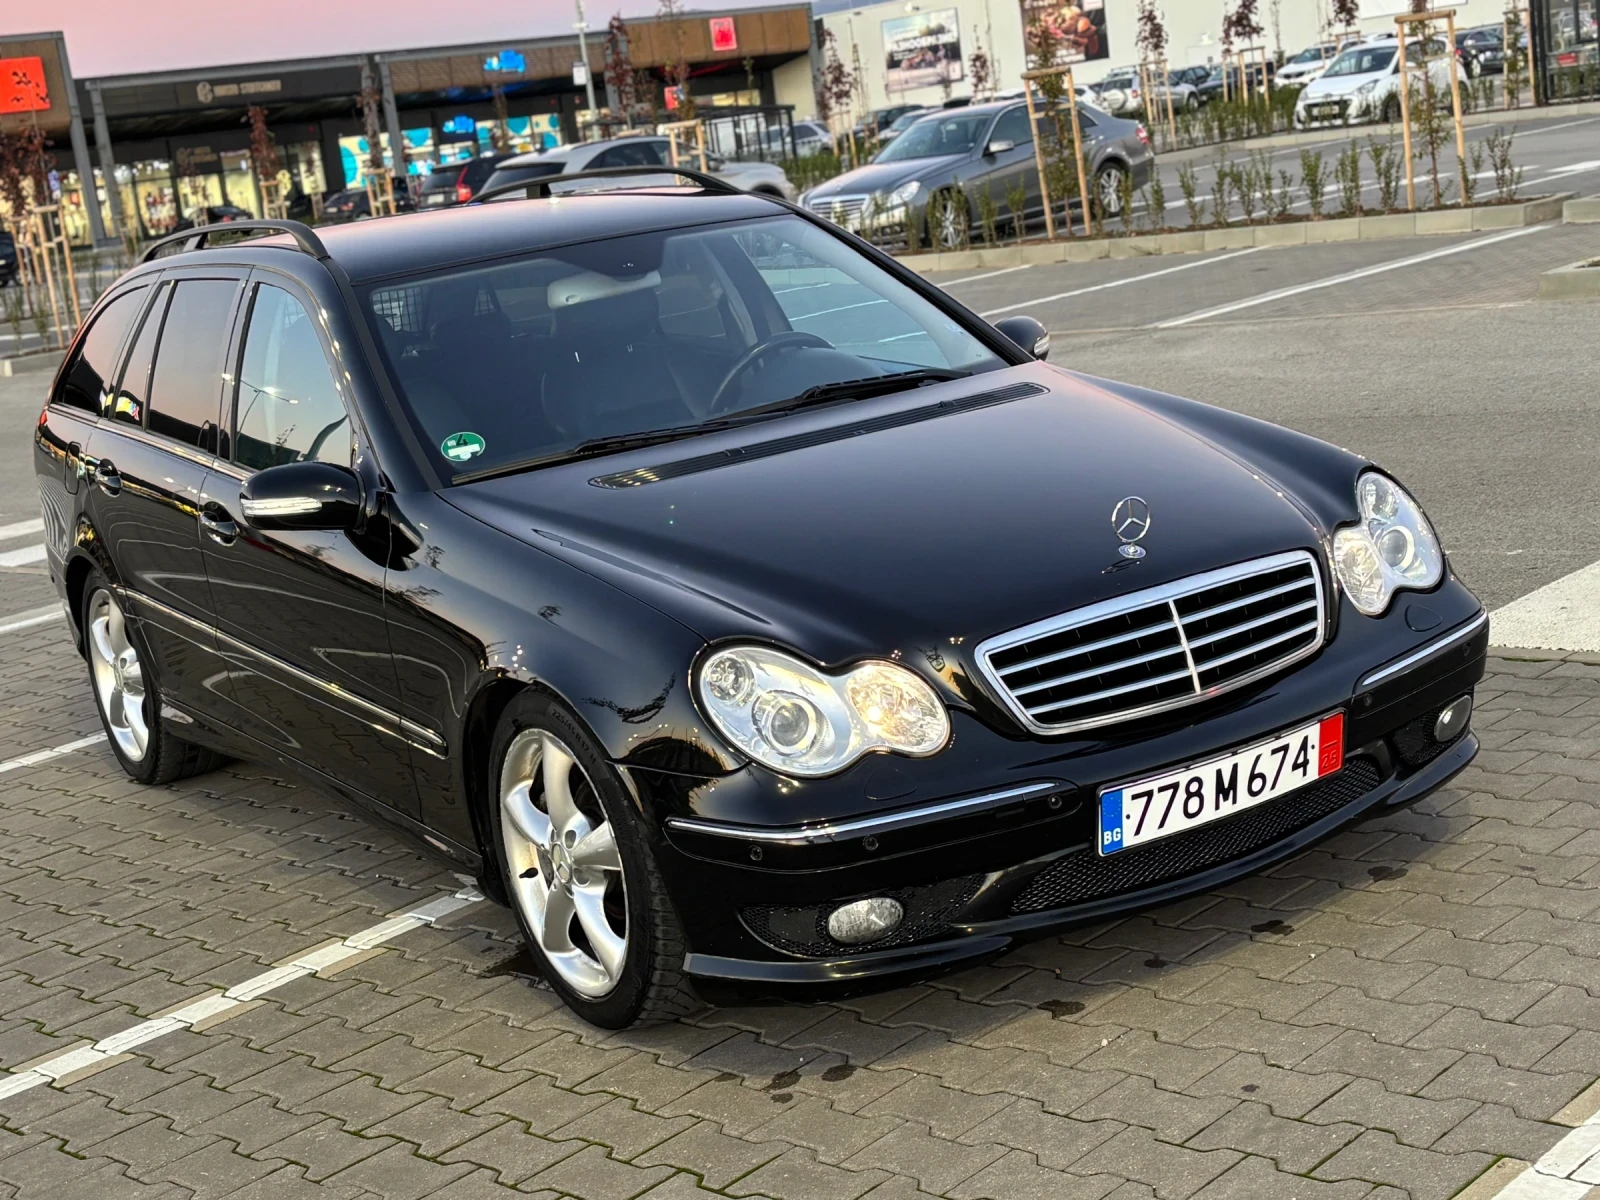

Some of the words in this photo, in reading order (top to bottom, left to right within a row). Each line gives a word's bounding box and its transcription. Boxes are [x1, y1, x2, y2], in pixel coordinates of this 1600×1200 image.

[456, 434, 468, 446] 4
[1130, 776, 1204, 837] 778
[1215, 762, 1238, 811] M
[1247, 735, 1310, 798] 674
[1103, 827, 1121, 845] BG
